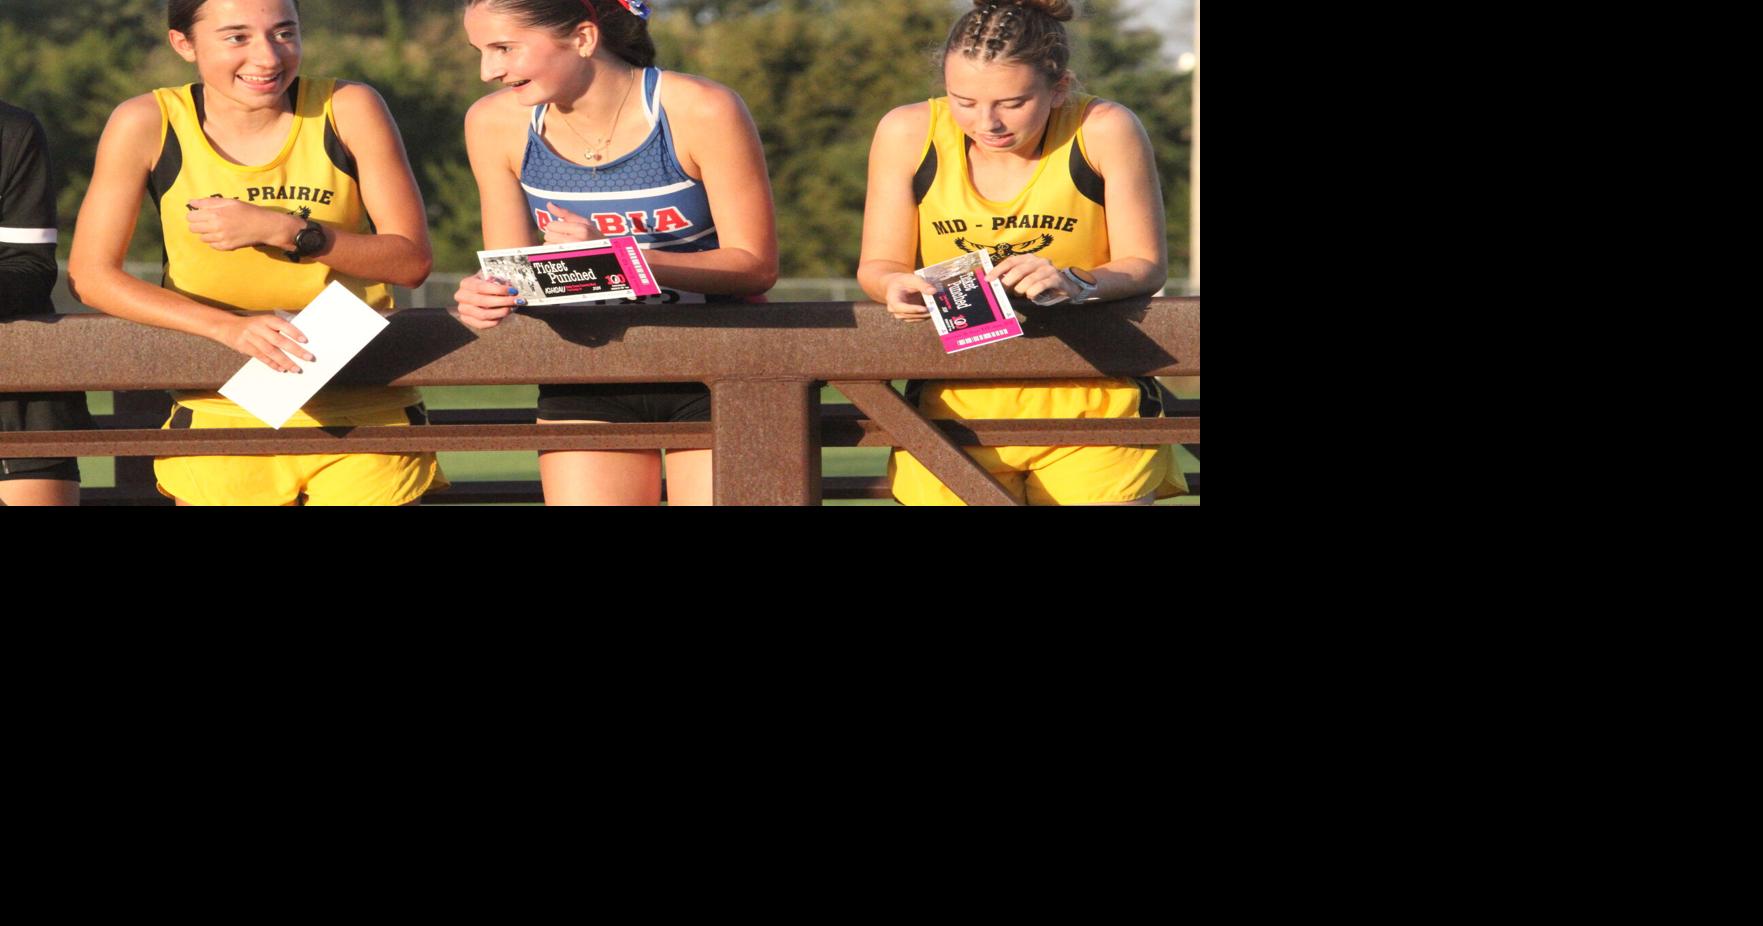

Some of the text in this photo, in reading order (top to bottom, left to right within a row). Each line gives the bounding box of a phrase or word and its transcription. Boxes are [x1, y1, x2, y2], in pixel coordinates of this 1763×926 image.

[246, 185, 335, 205] PRAIRIE
[534, 205, 694, 236] ABIA
[931, 218, 968, 235] MID
[991, 214, 1079, 233] PRAIRIE
[532, 260, 569, 275] Ticket
[547, 268, 598, 285] Punched
[947, 280, 973, 310] Punched
